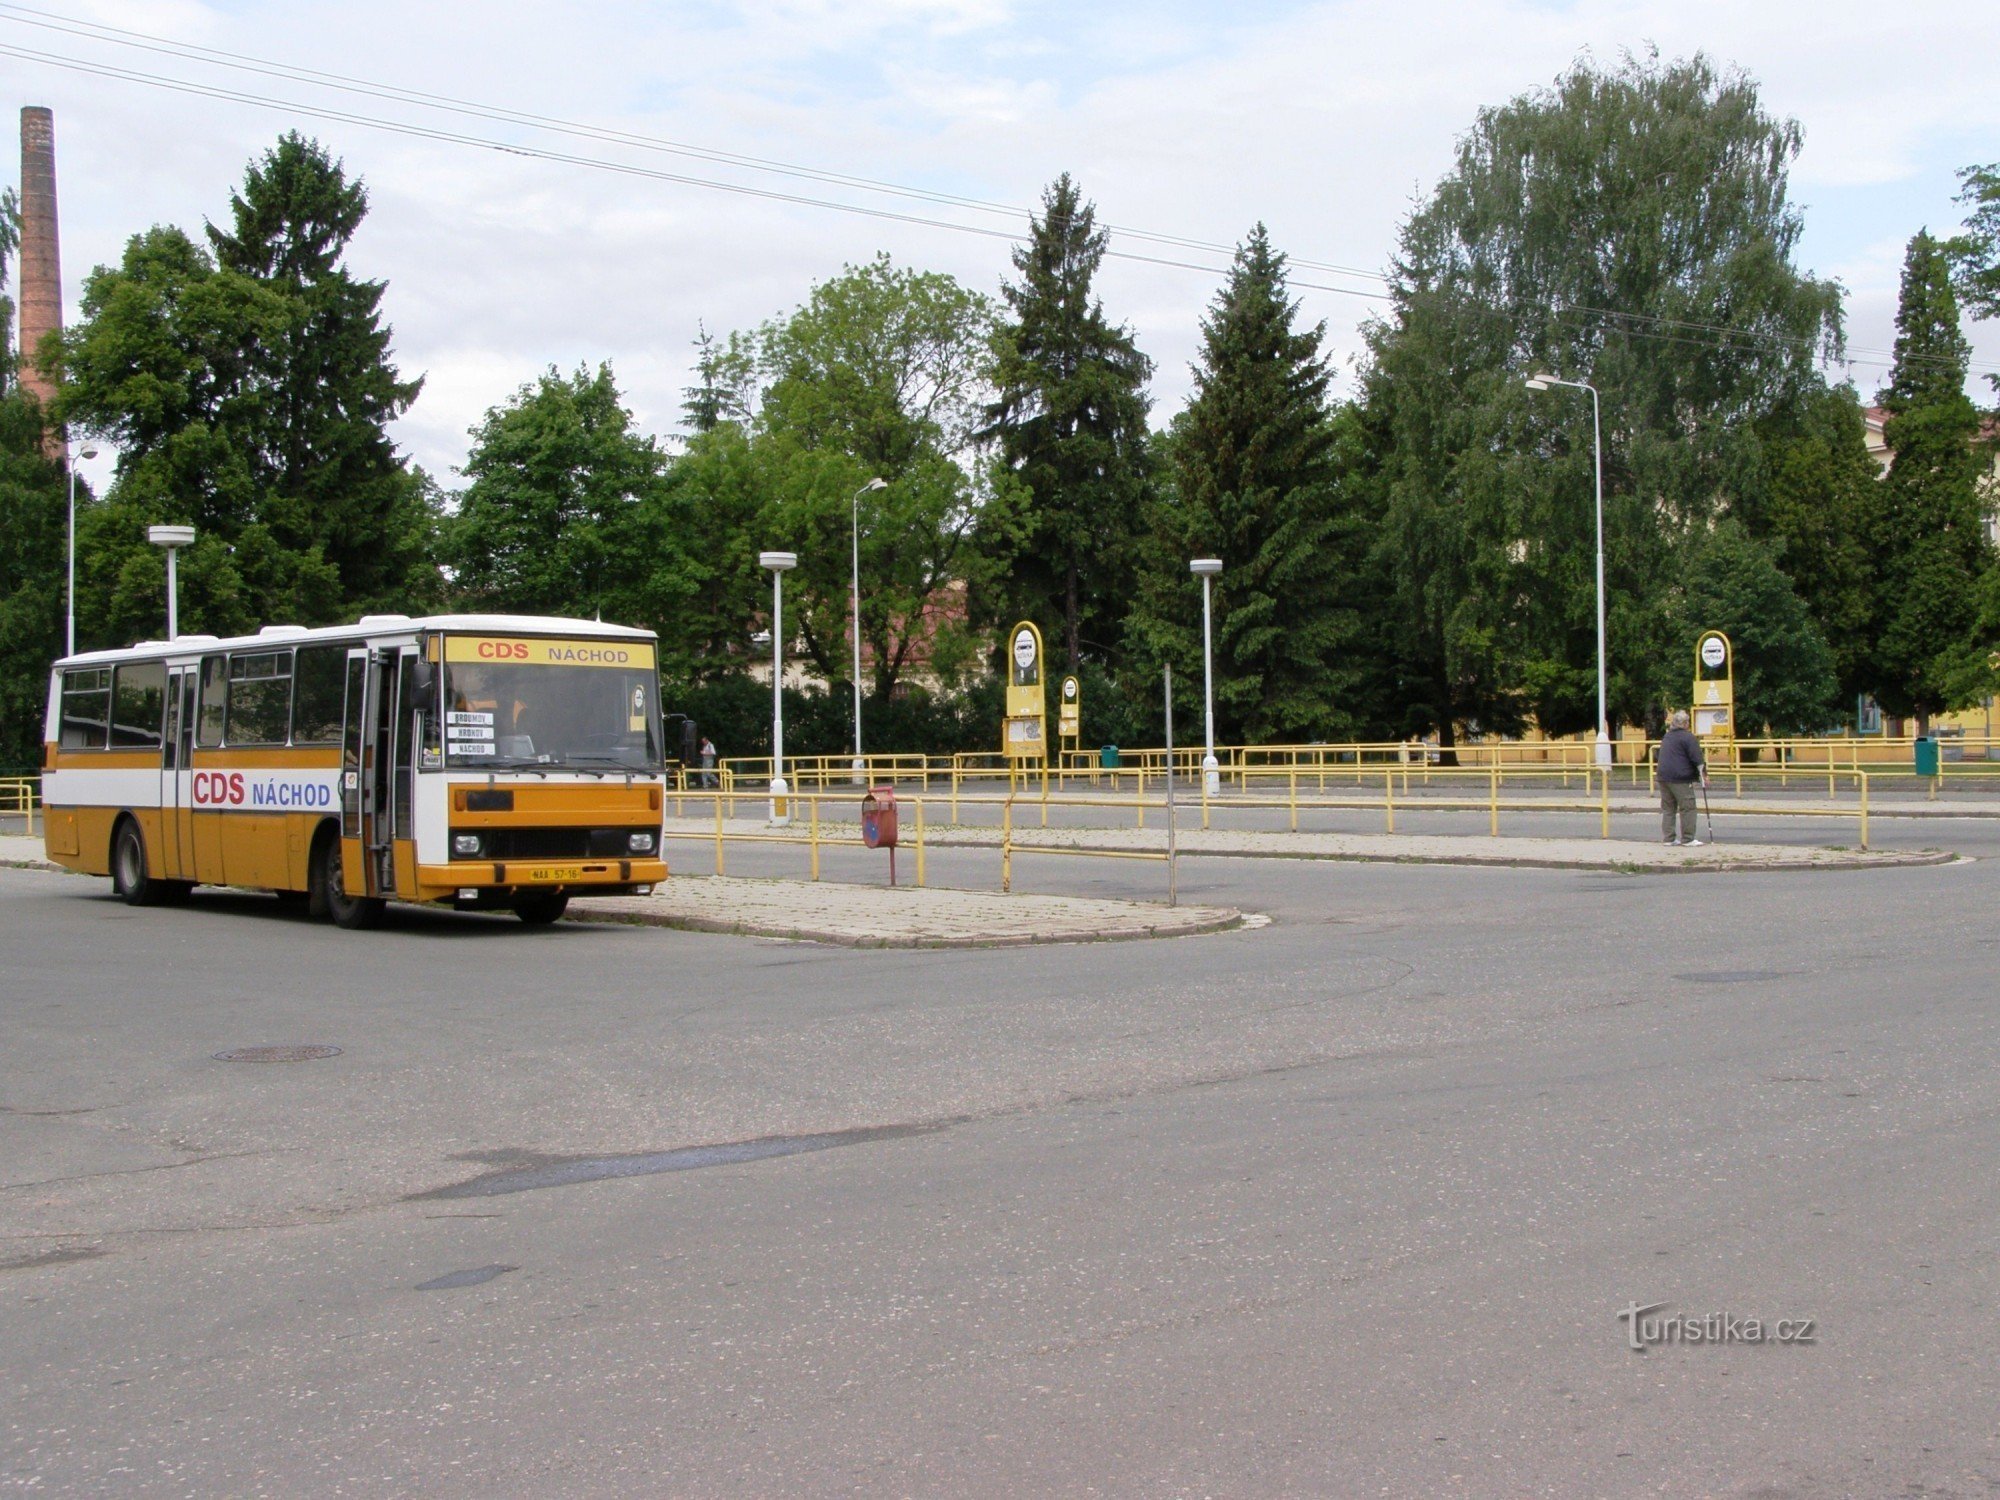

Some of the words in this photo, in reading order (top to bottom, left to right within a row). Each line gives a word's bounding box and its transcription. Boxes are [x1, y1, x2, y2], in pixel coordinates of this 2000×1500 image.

[478, 642, 529, 659] CDS
[549, 646, 629, 663] NÁCHOD
[194, 772, 245, 805] CDS
[253, 778, 331, 806] NÁCHOD
